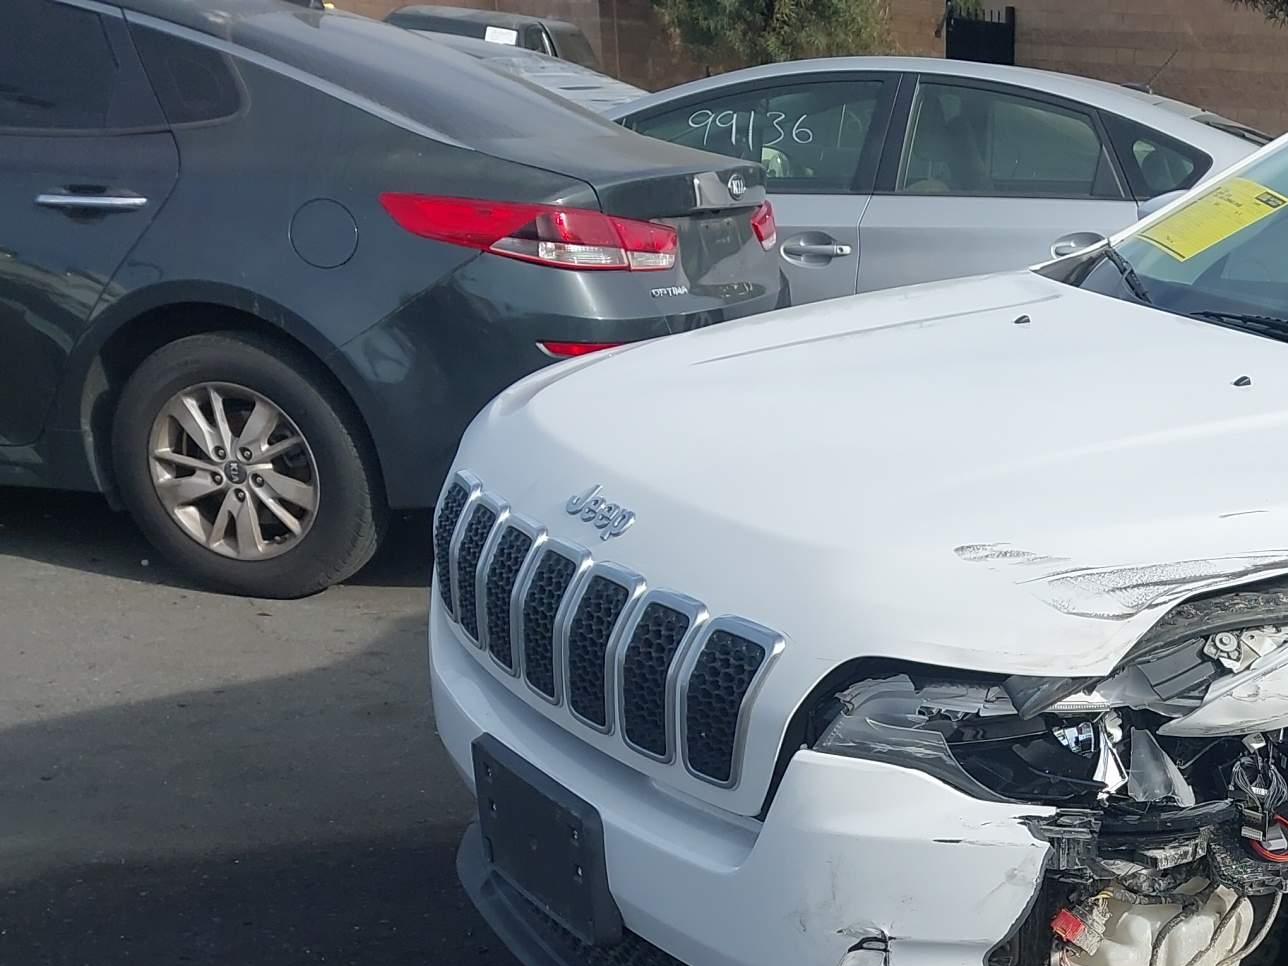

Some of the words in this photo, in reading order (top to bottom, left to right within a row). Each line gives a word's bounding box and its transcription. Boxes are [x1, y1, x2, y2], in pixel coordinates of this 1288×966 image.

[688, 109, 813, 150] 99136
[230, 462, 240, 482] KIA
[566, 484, 635, 541] Jeep
